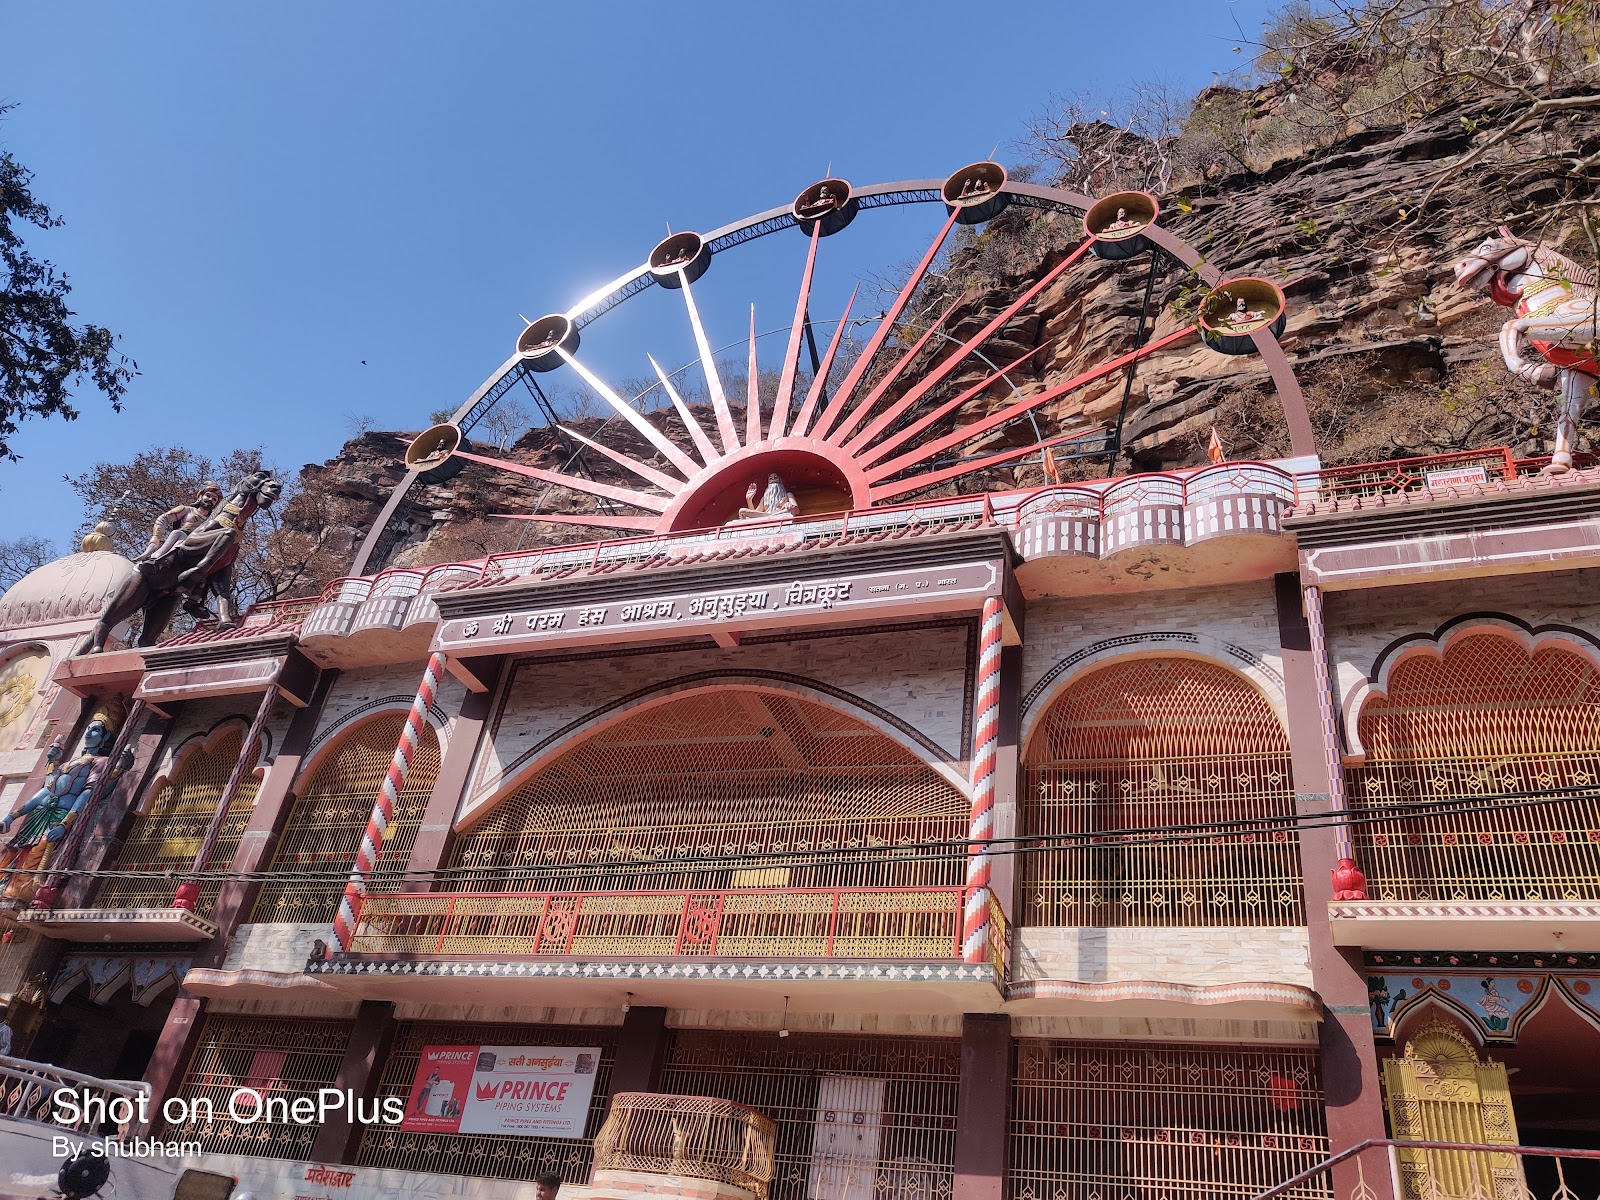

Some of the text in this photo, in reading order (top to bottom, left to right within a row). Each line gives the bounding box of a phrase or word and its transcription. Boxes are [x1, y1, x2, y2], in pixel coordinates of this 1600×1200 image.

[1430, 473, 1484, 487] महाराणा प्रताप
[463, 620, 480, 639] ॐ
[491, 613, 513, 635] श्री
[525, 613, 565, 630] परम
[578, 607, 608, 626] हंस
[784, 581, 852, 609] चित्रकूट
[439, 1051, 474, 1060] PRINCE
[508, 1055, 526, 1067] सती
[499, 1080, 570, 1101] PRINCE
[494, 1102, 563, 1113] PIPING SYSTEMS
